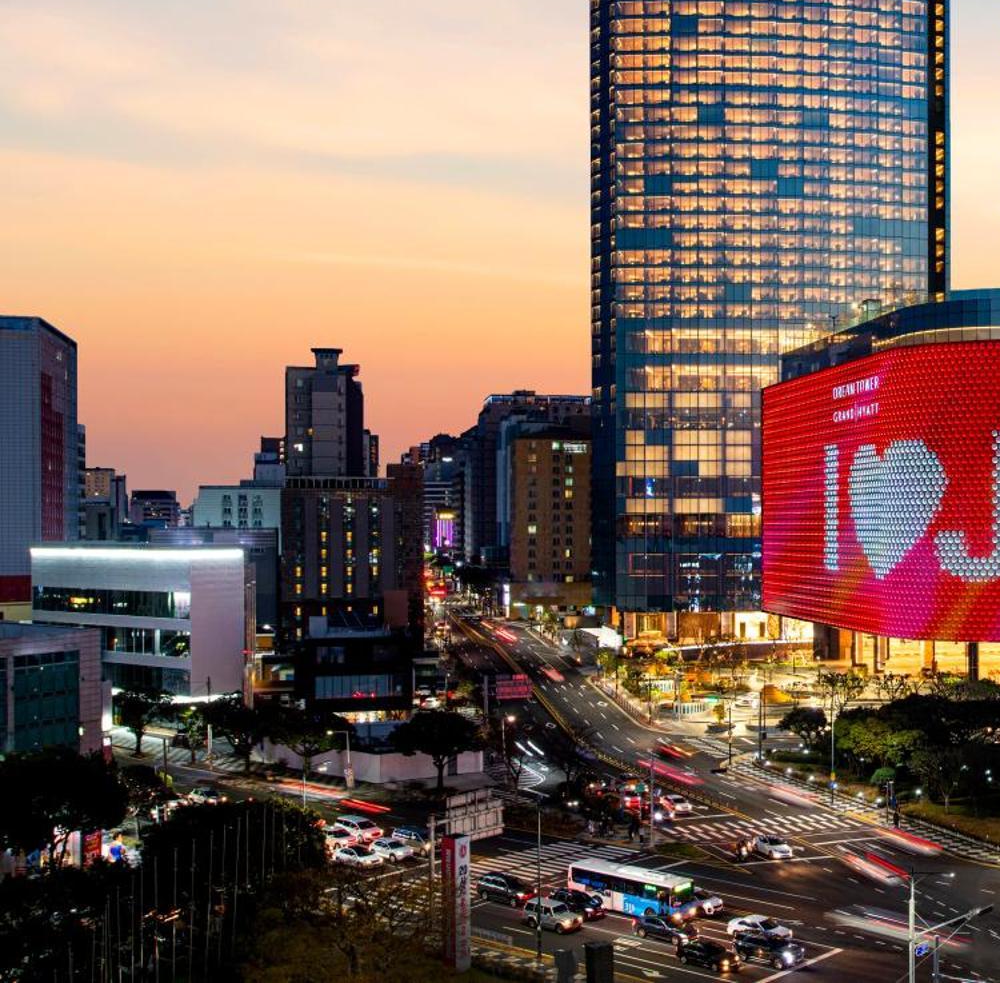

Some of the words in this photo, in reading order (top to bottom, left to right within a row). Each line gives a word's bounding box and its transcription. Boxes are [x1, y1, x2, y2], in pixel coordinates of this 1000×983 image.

[832, 407, 854, 423] GRAND
[857, 403, 880, 418] HYATT
[824, 444, 840, 571] I
